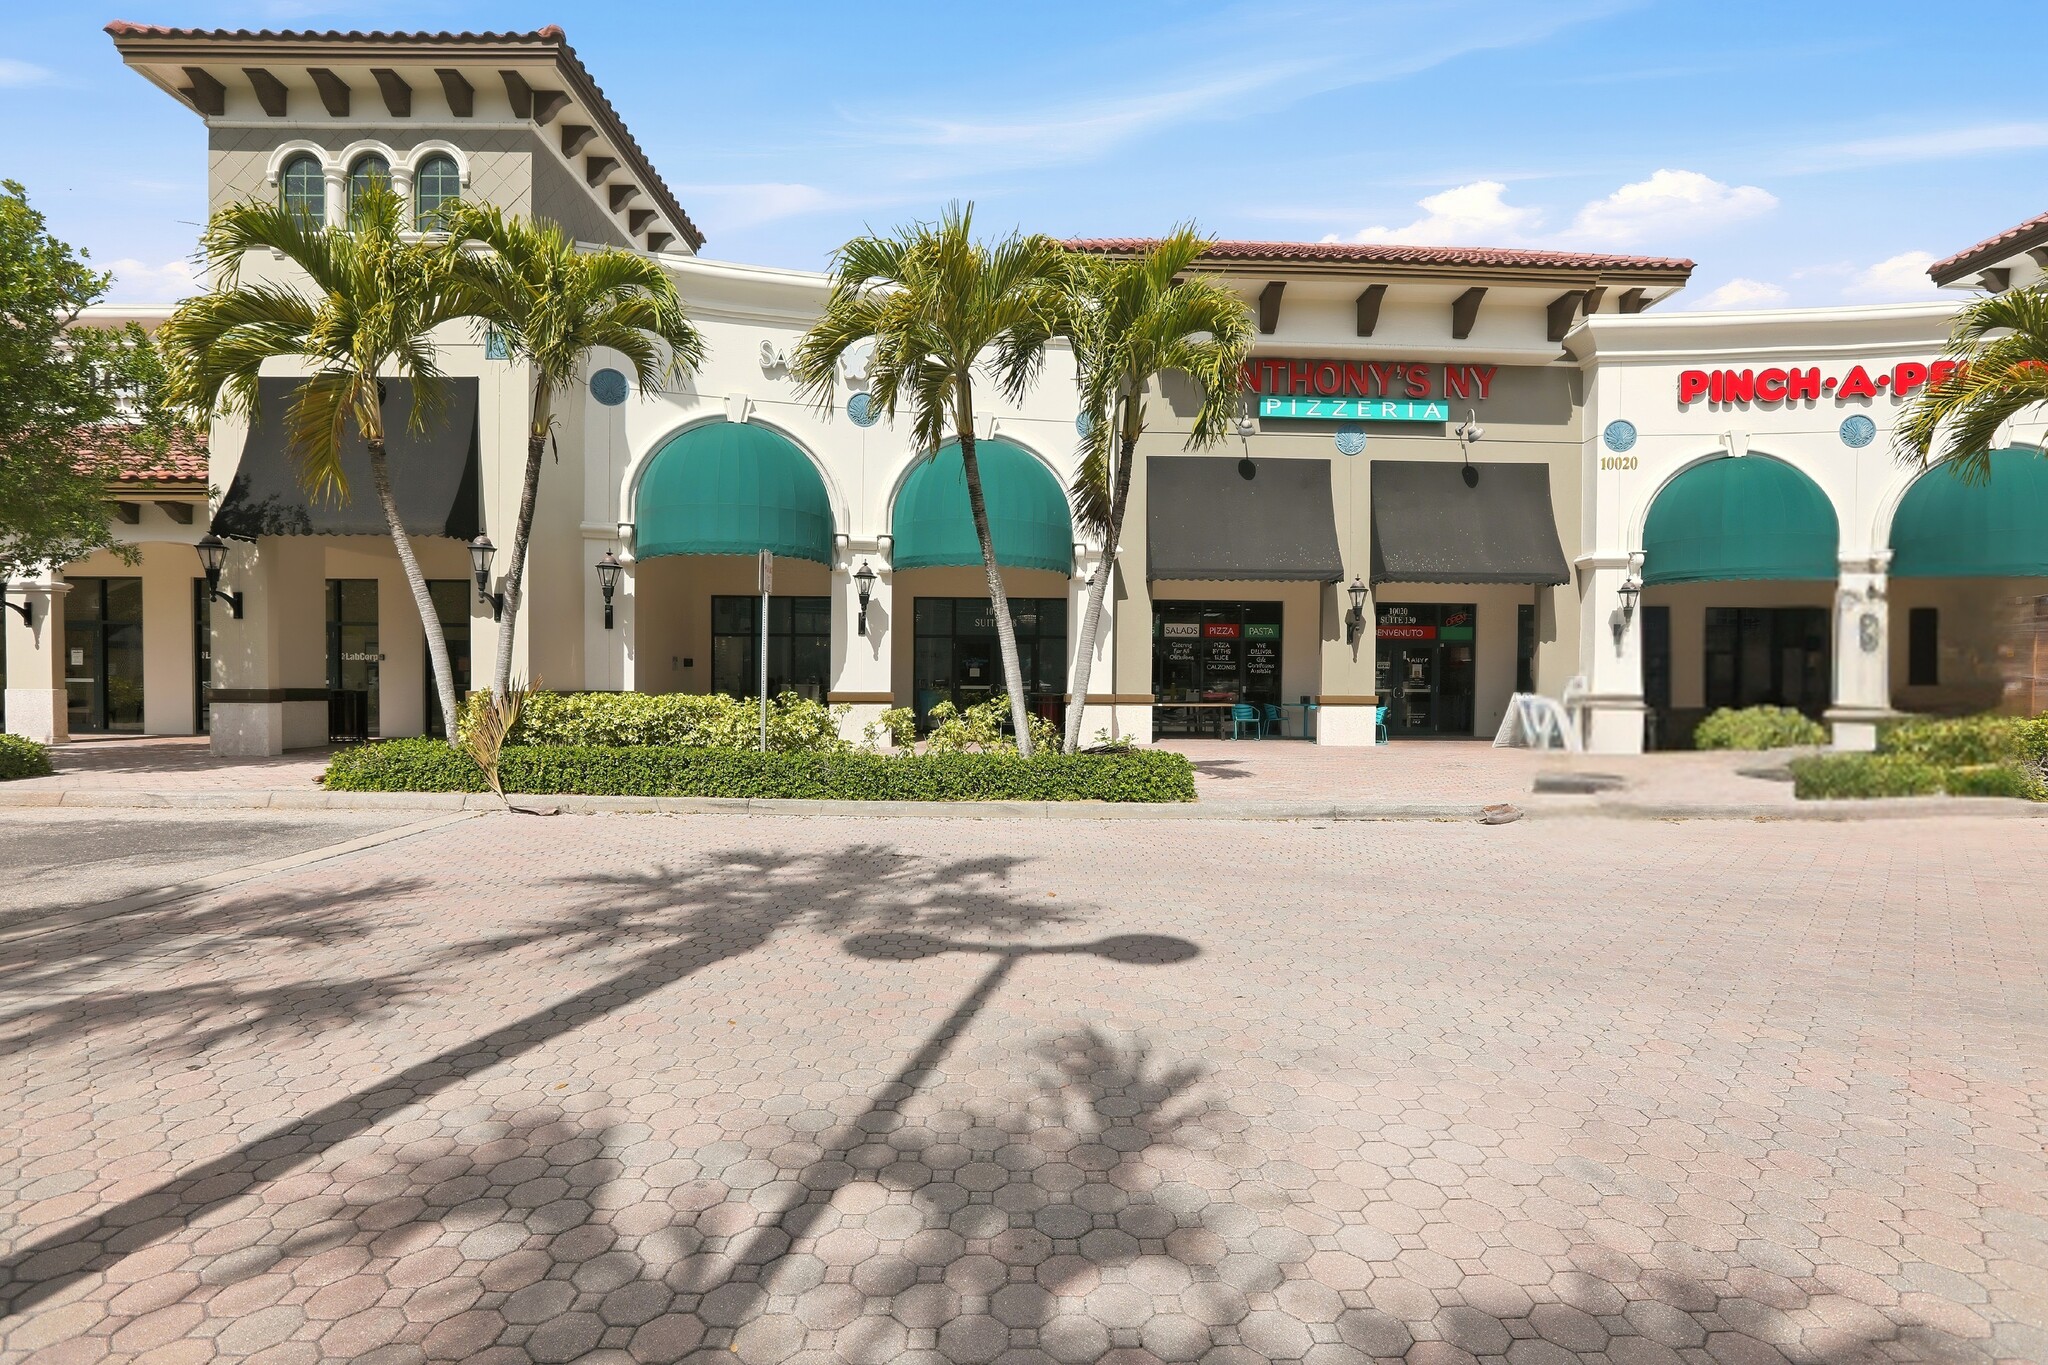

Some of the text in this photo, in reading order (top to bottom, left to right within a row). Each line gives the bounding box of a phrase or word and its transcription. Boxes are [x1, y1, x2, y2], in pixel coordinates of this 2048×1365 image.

[1228, 359, 1498, 400] NTHONY'S NY
[1266, 398, 1441, 419] PIZZERIA
[1600, 456, 1638, 471] 10020
[974, 618, 996, 627] SUIT
[1165, 626, 1198, 635] SALADS
[1209, 626, 1235, 635] PIZZA
[1249, 627, 1274, 635] PASTA
[1376, 629, 1424, 637] ENVENUTO
